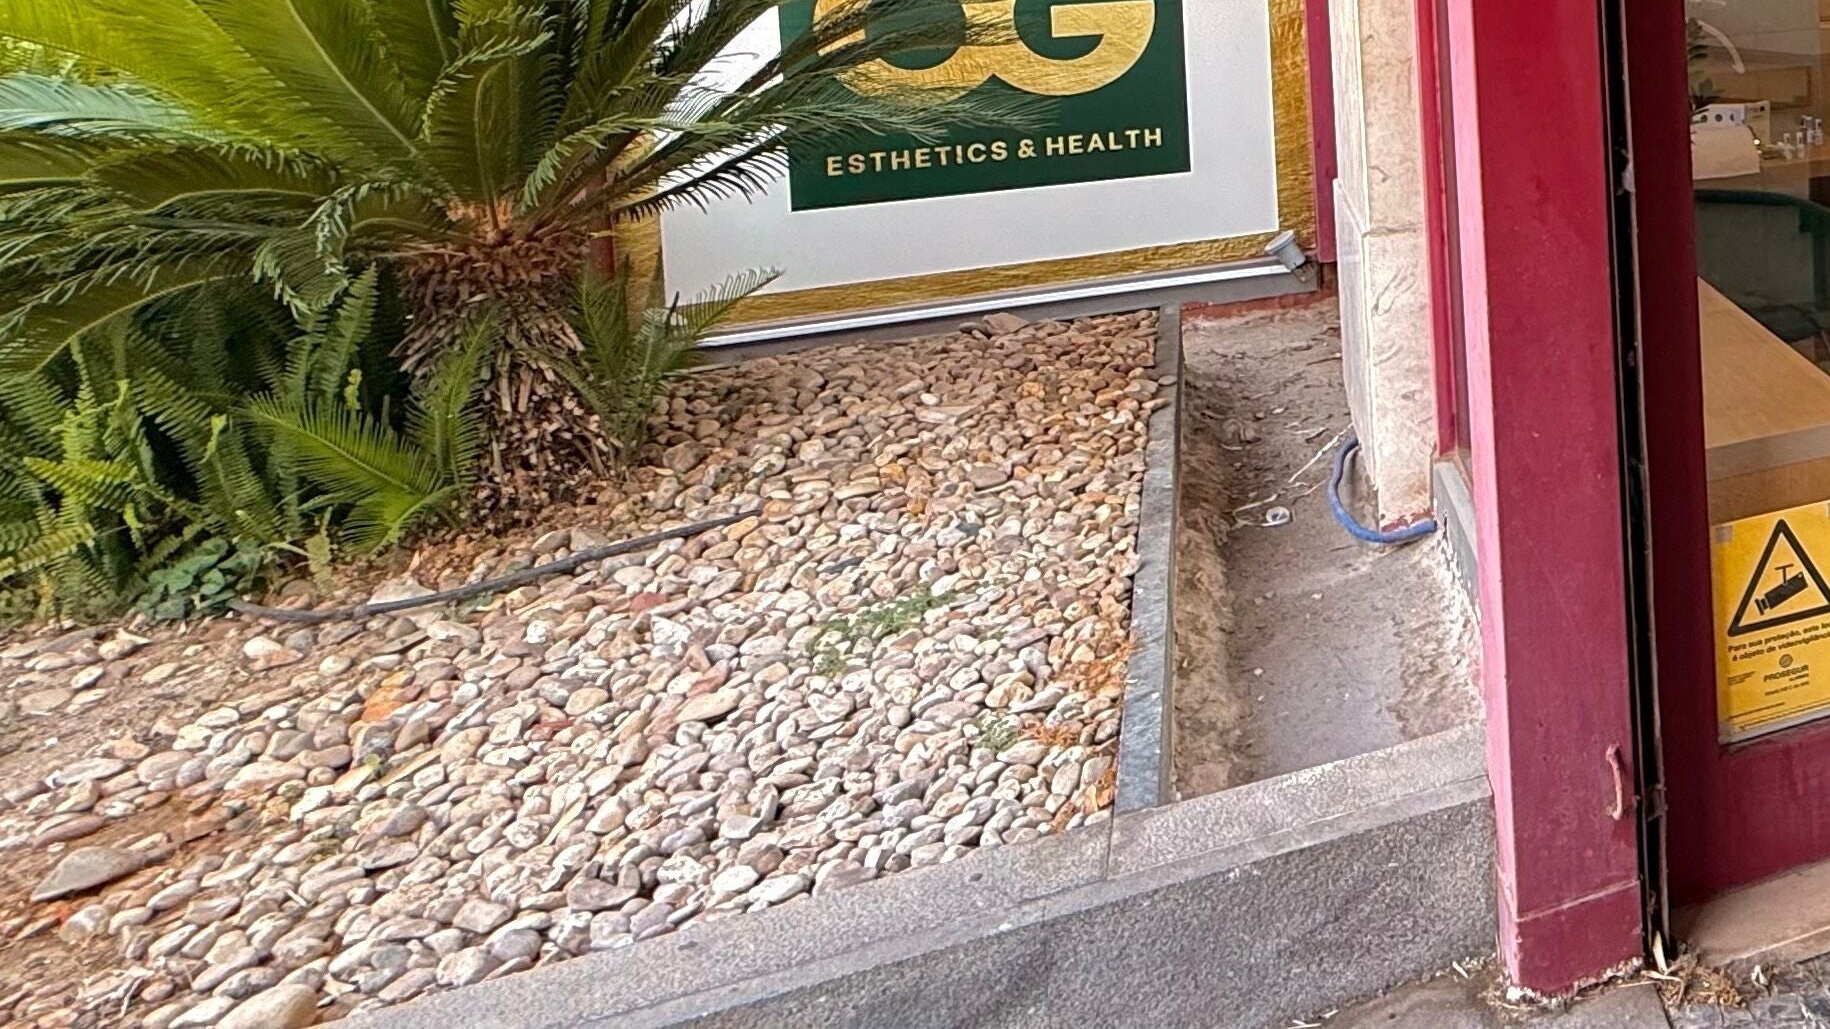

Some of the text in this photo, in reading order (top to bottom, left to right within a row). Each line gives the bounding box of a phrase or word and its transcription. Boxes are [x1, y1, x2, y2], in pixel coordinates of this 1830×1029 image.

[826, 127, 1164, 177] ESTHETICS & HEALTH
[1763, 664, 1809, 683] PROSEGUR
